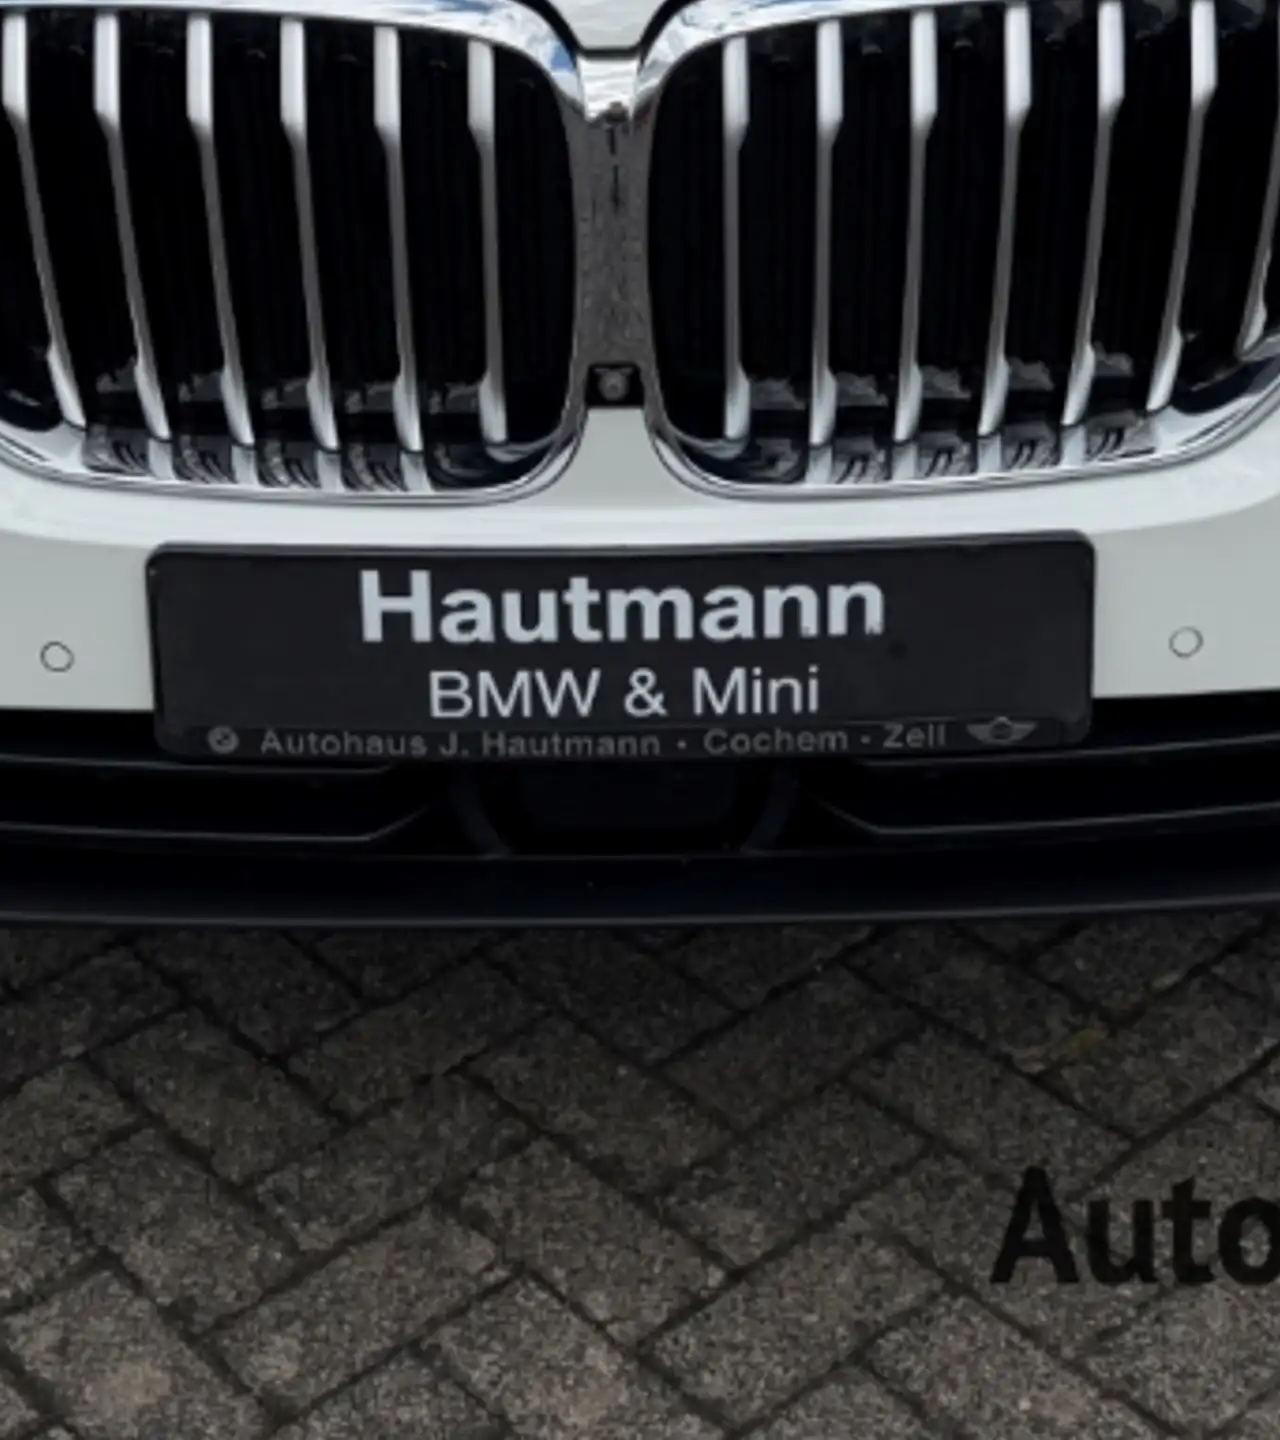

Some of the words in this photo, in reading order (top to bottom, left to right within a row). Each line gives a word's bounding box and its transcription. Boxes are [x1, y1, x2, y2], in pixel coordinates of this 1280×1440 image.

[359, 569, 885, 644] Hautmann
[429, 667, 601, 718] BMW
[624, 667, 667, 717] &
[693, 665, 820, 715] Mini
[260, 728, 428, 757] Autohaus
[439, 731, 469, 756] J.
[481, 730, 661, 757] Hautmann
[703, 726, 848, 755] Cochem
[882, 722, 946, 748] Zell
